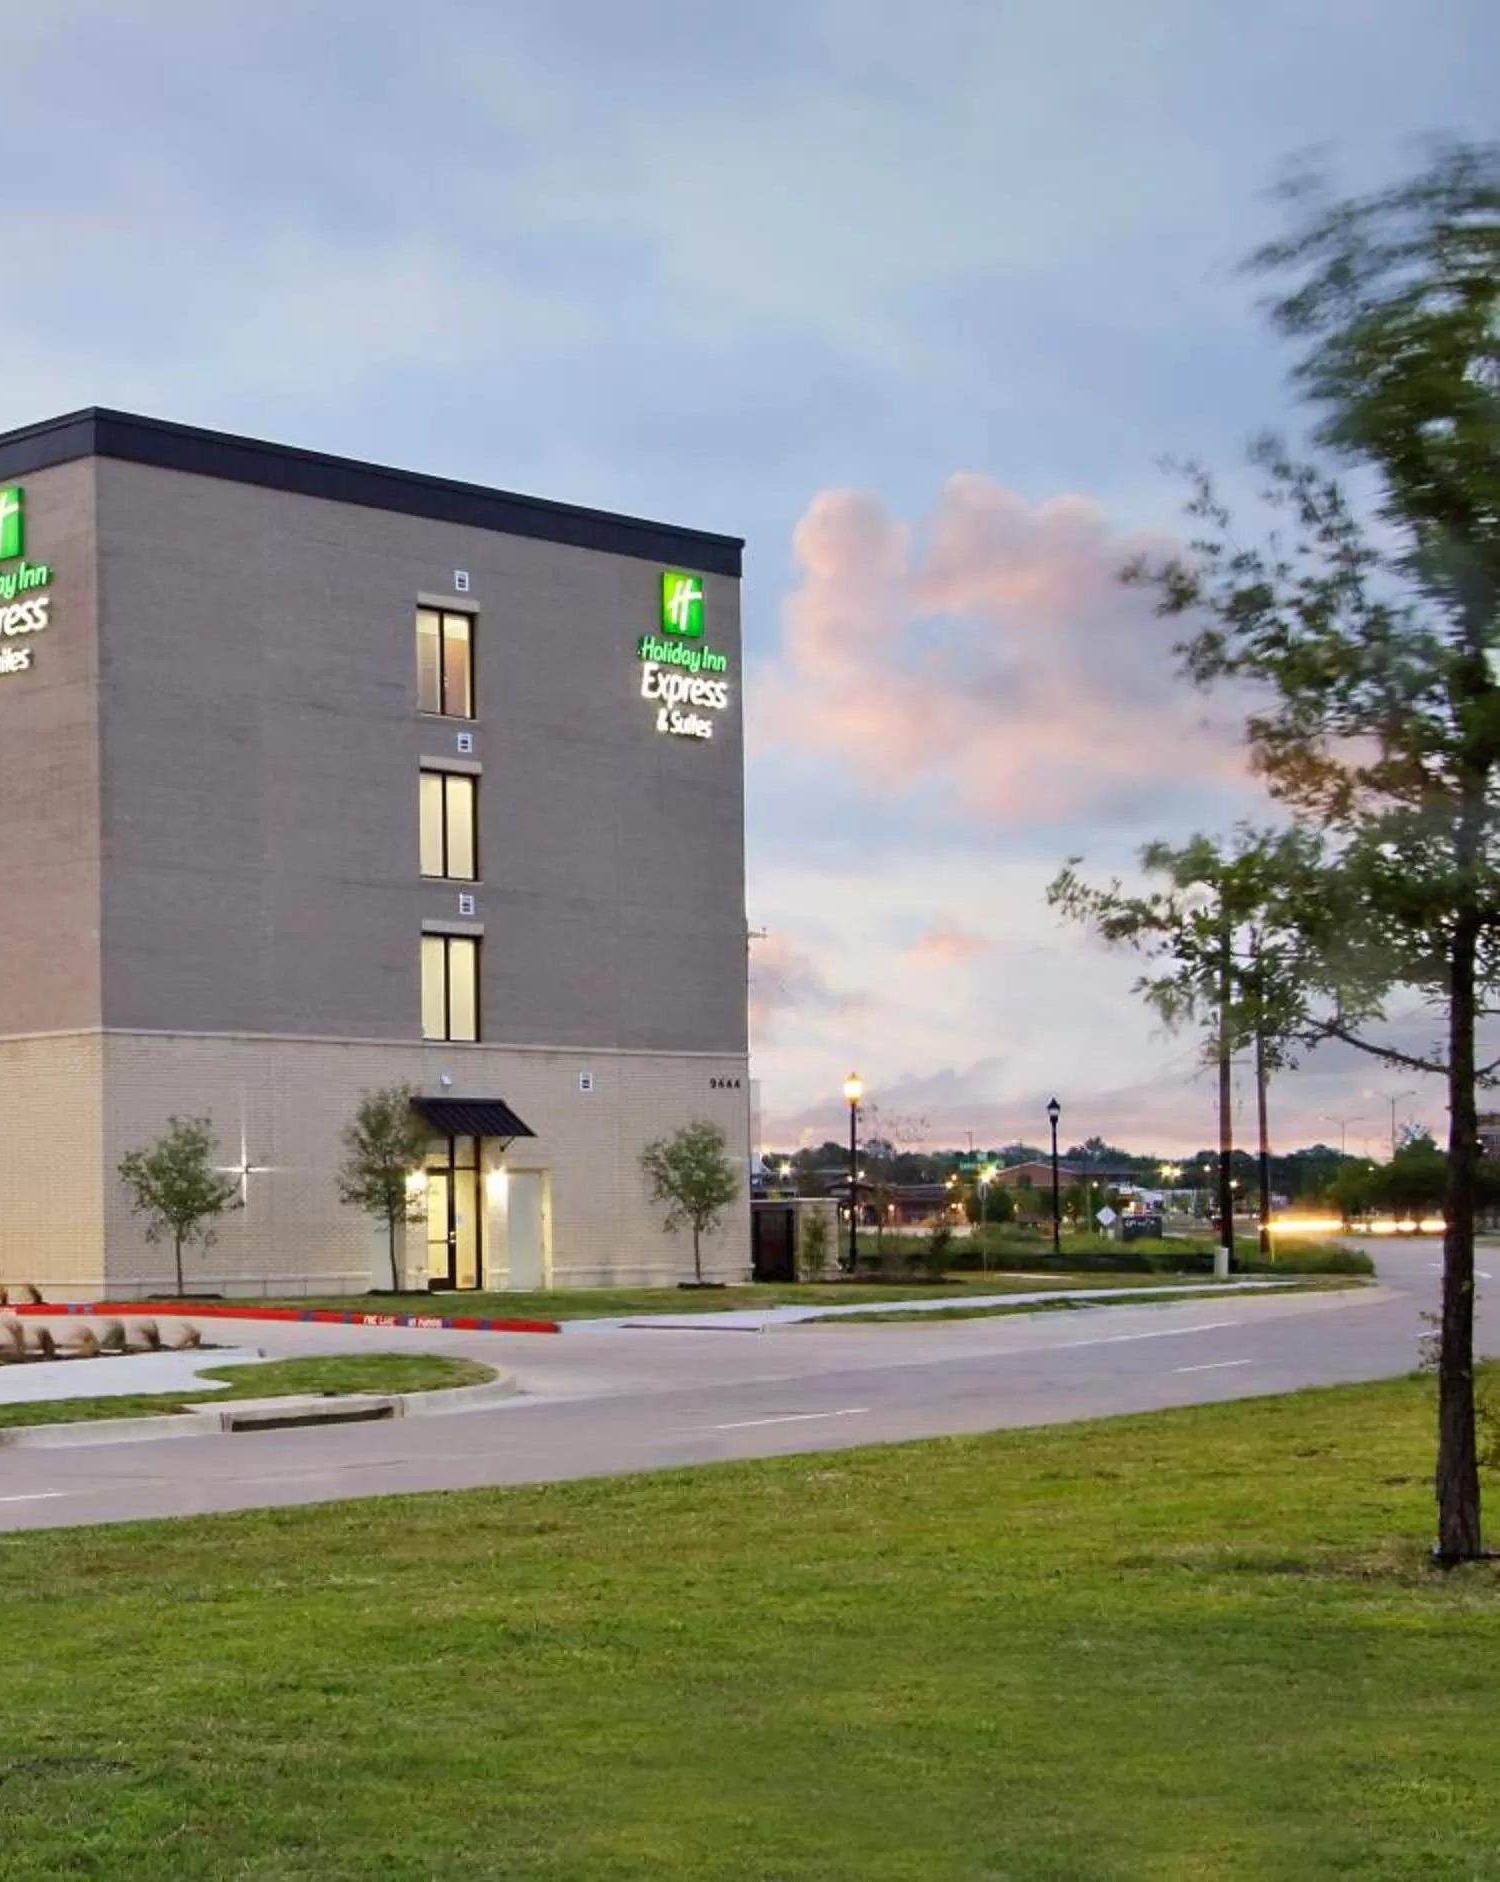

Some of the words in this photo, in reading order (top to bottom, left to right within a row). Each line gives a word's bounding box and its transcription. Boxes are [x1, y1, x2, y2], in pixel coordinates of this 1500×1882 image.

[19, 561, 48, 589] Inn
[642, 635, 700, 673] Holiday
[702, 645, 727, 672] Inn
[640, 662, 727, 709] Express
[656, 707, 668, 732] &
[670, 710, 713, 738] Suites
